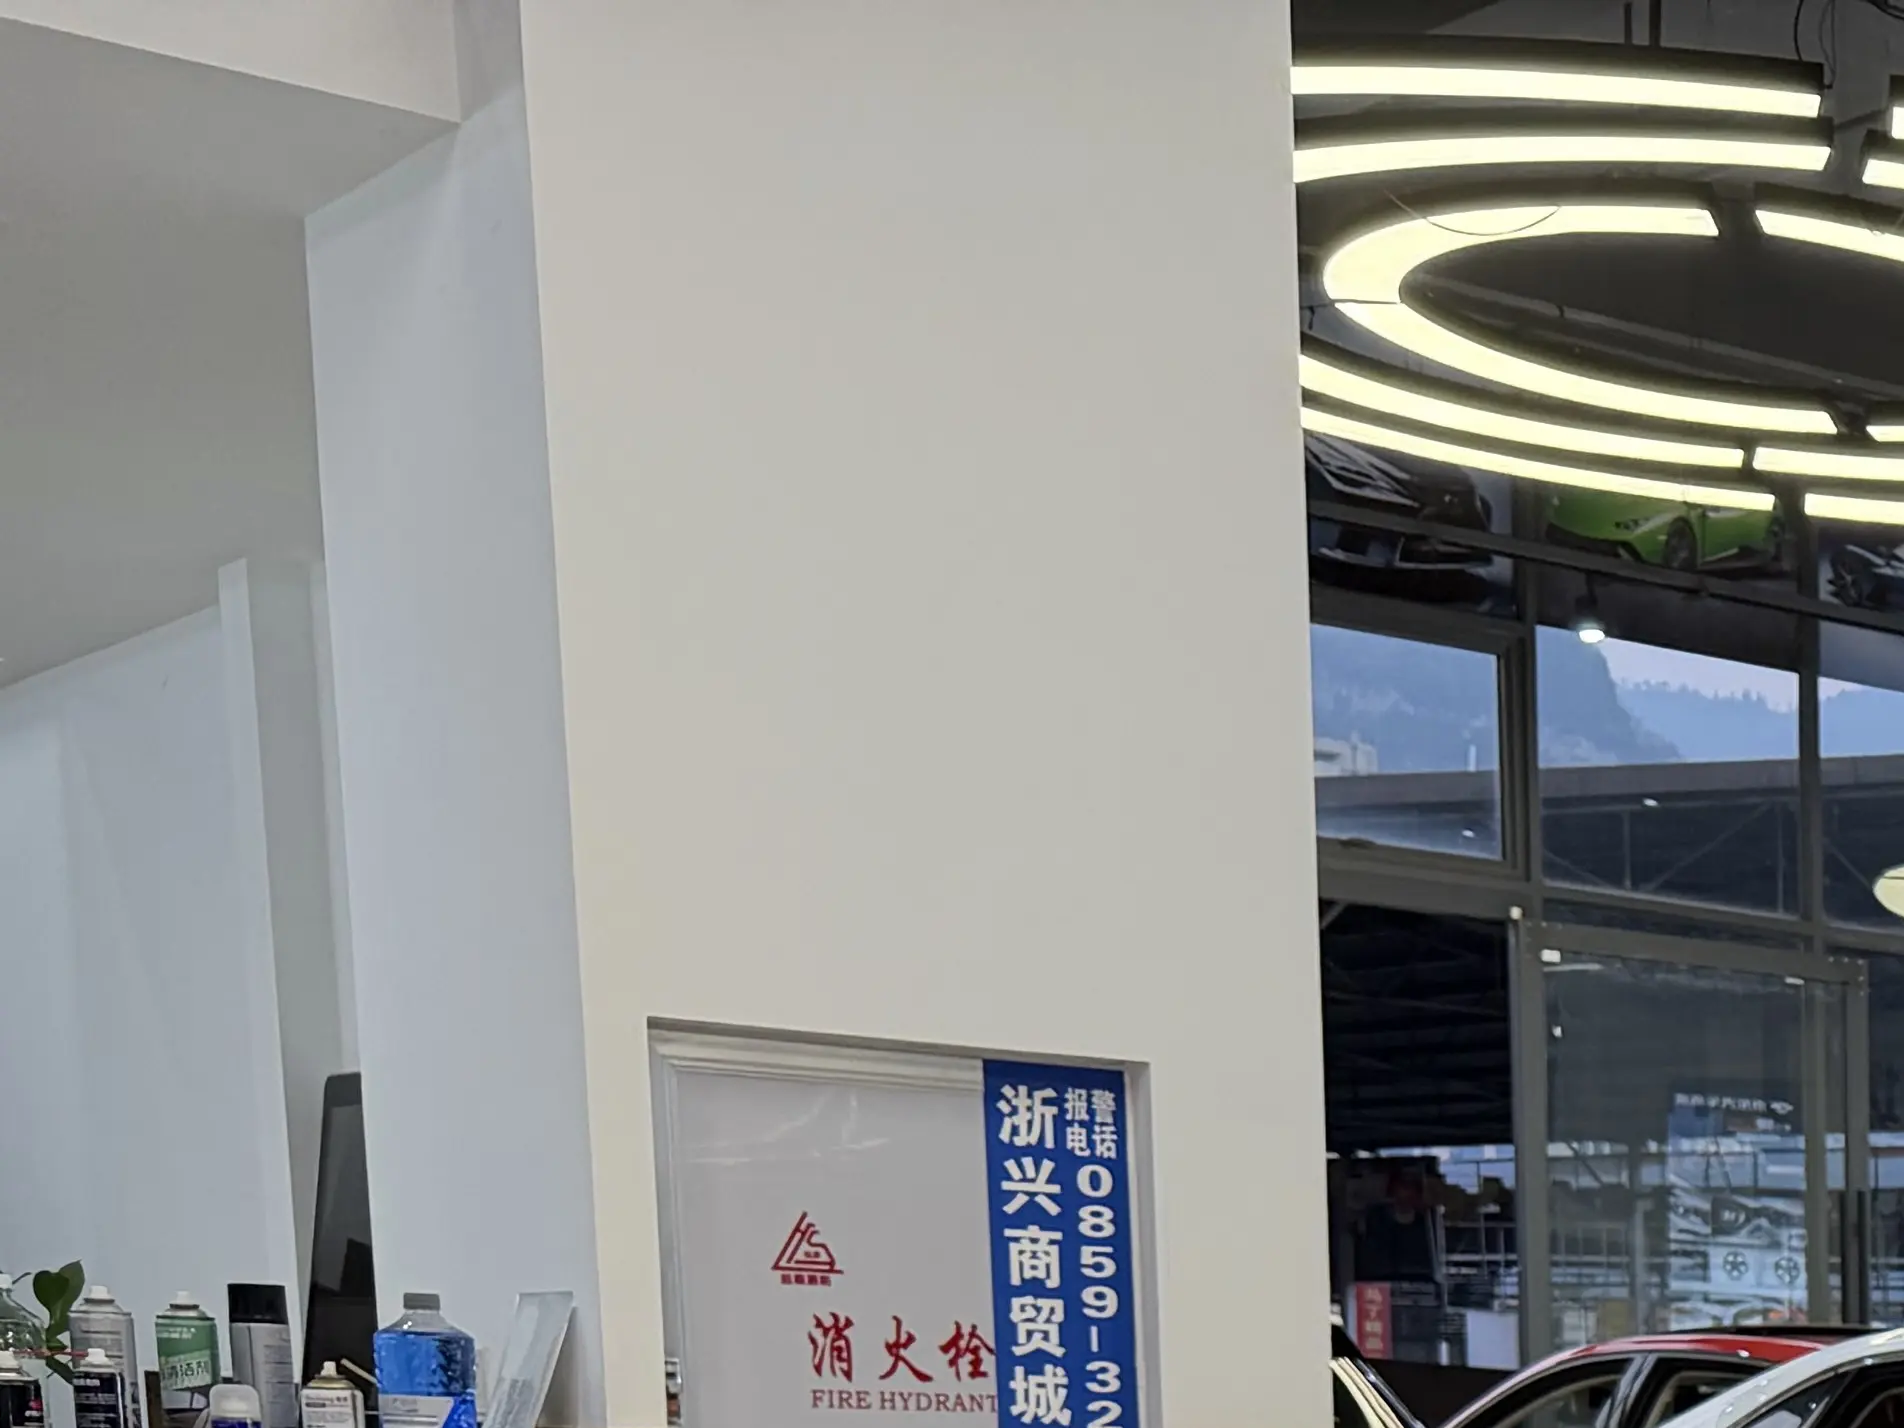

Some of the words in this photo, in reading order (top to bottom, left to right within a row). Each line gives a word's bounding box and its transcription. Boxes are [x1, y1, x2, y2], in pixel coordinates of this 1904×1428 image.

[807, 1311, 997, 1383] 消火栓
[810, 1389, 872, 1410] FIRE
[878, 1391, 998, 1413] HYDRANT
